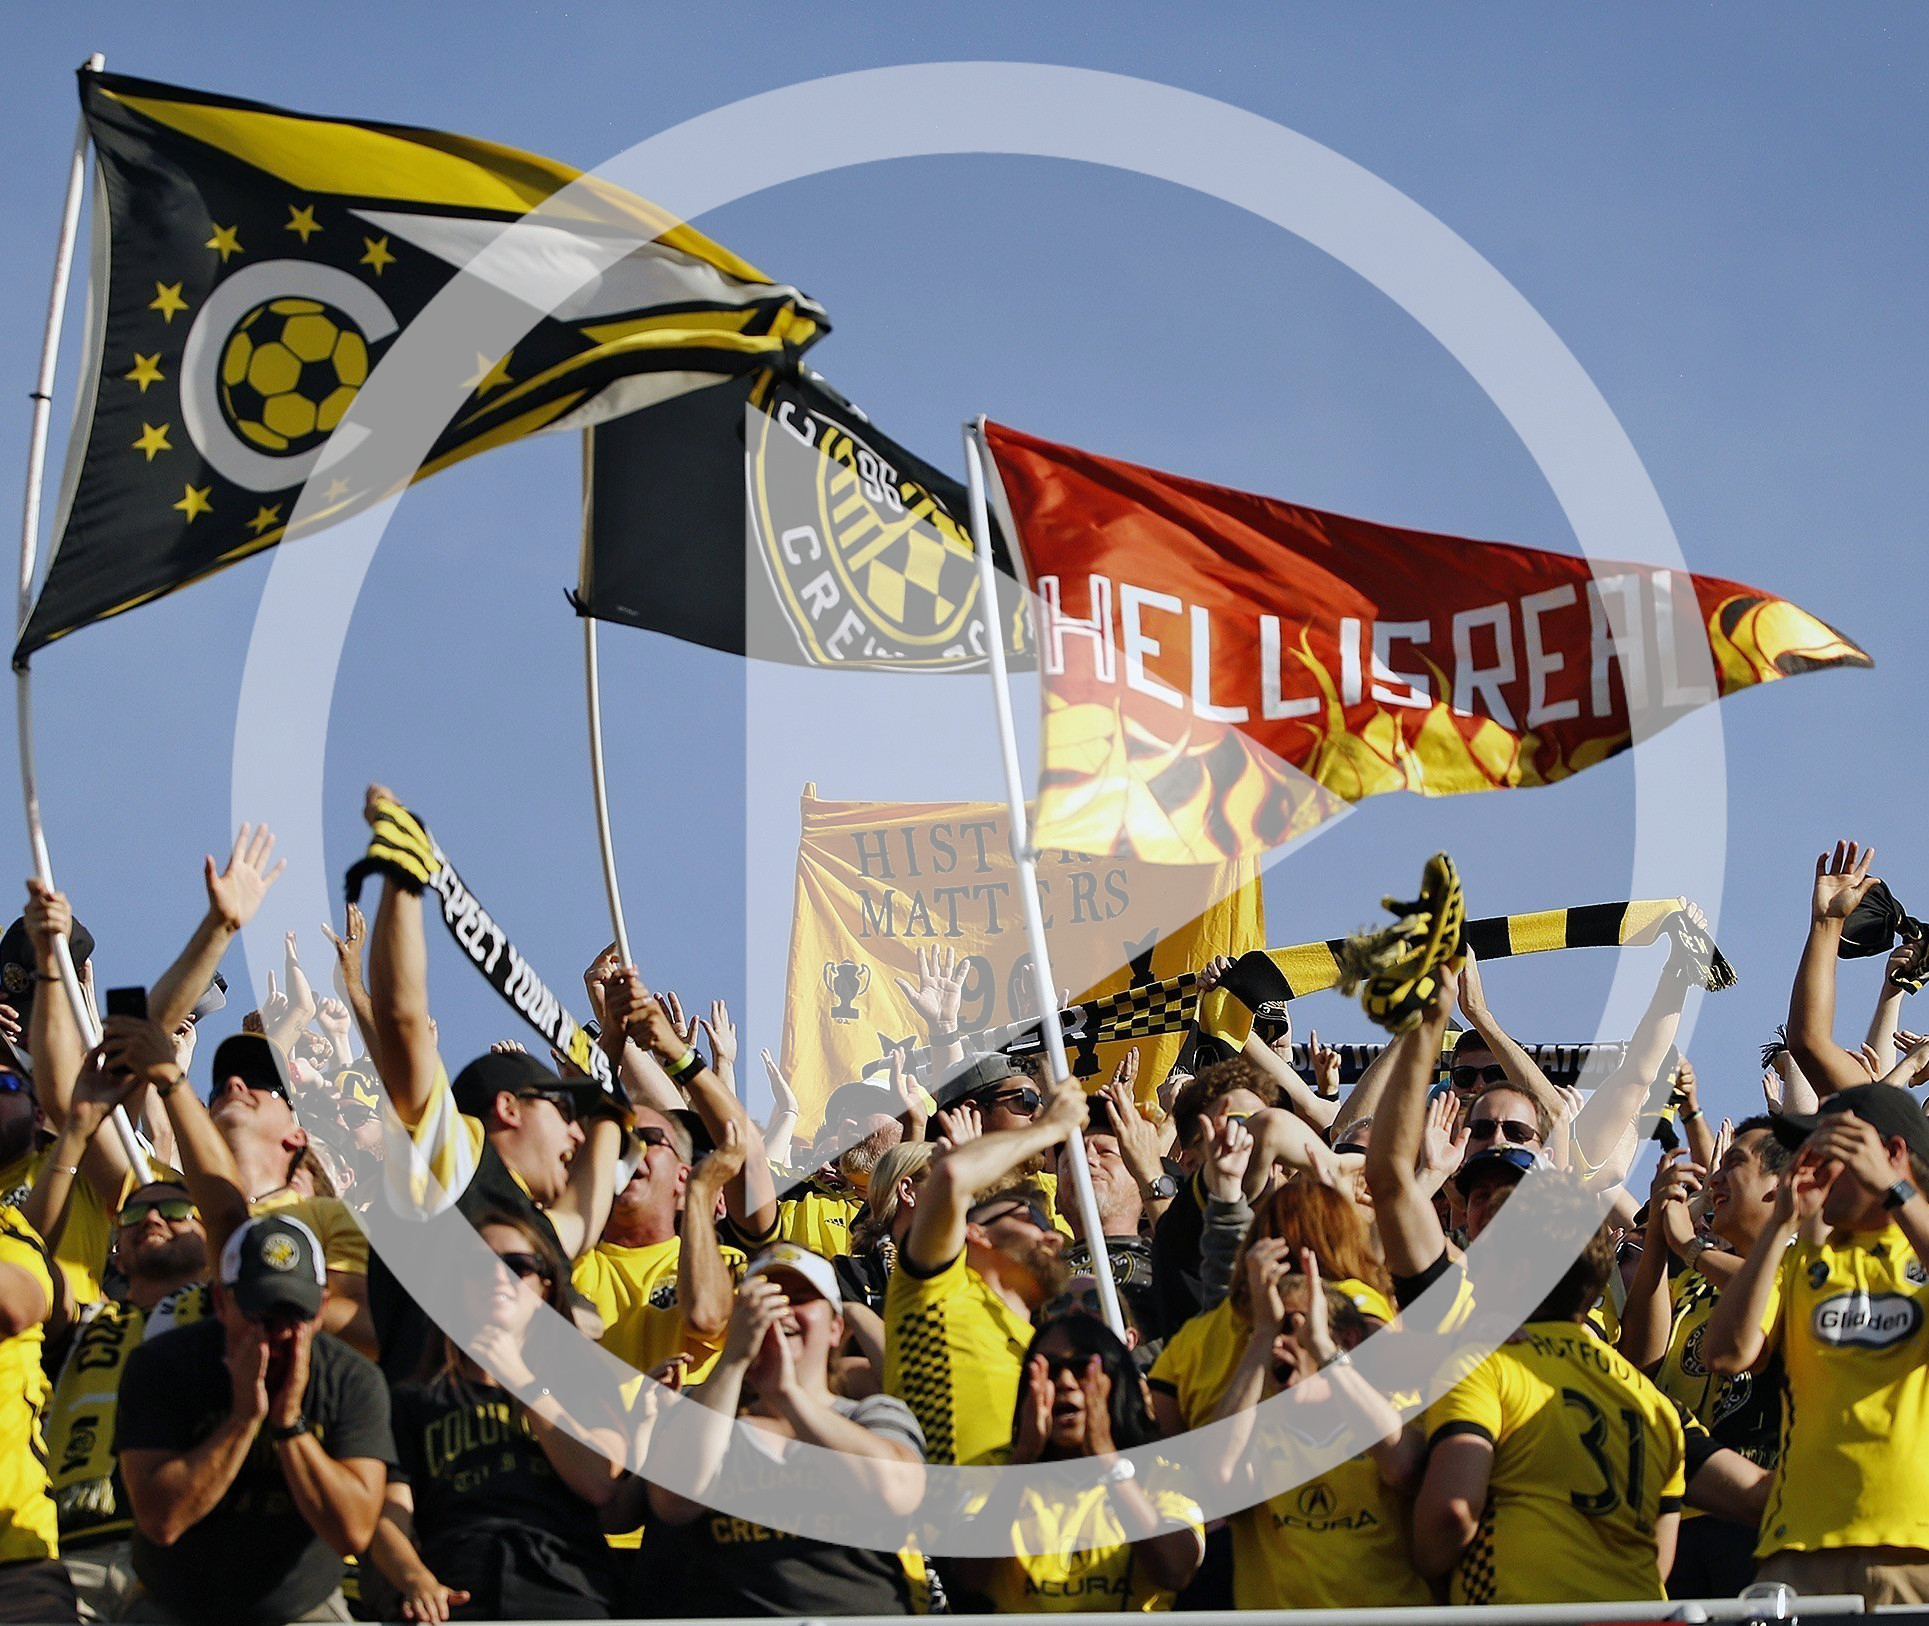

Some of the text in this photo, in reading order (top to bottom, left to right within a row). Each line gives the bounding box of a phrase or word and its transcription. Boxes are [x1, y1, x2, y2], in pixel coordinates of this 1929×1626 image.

[851, 820, 1104, 878] HIST
[1821, 1309, 1908, 1331] Glidden
[1563, 1387, 1651, 1533] 31
[1024, 1573, 1133, 1598] ACURA
